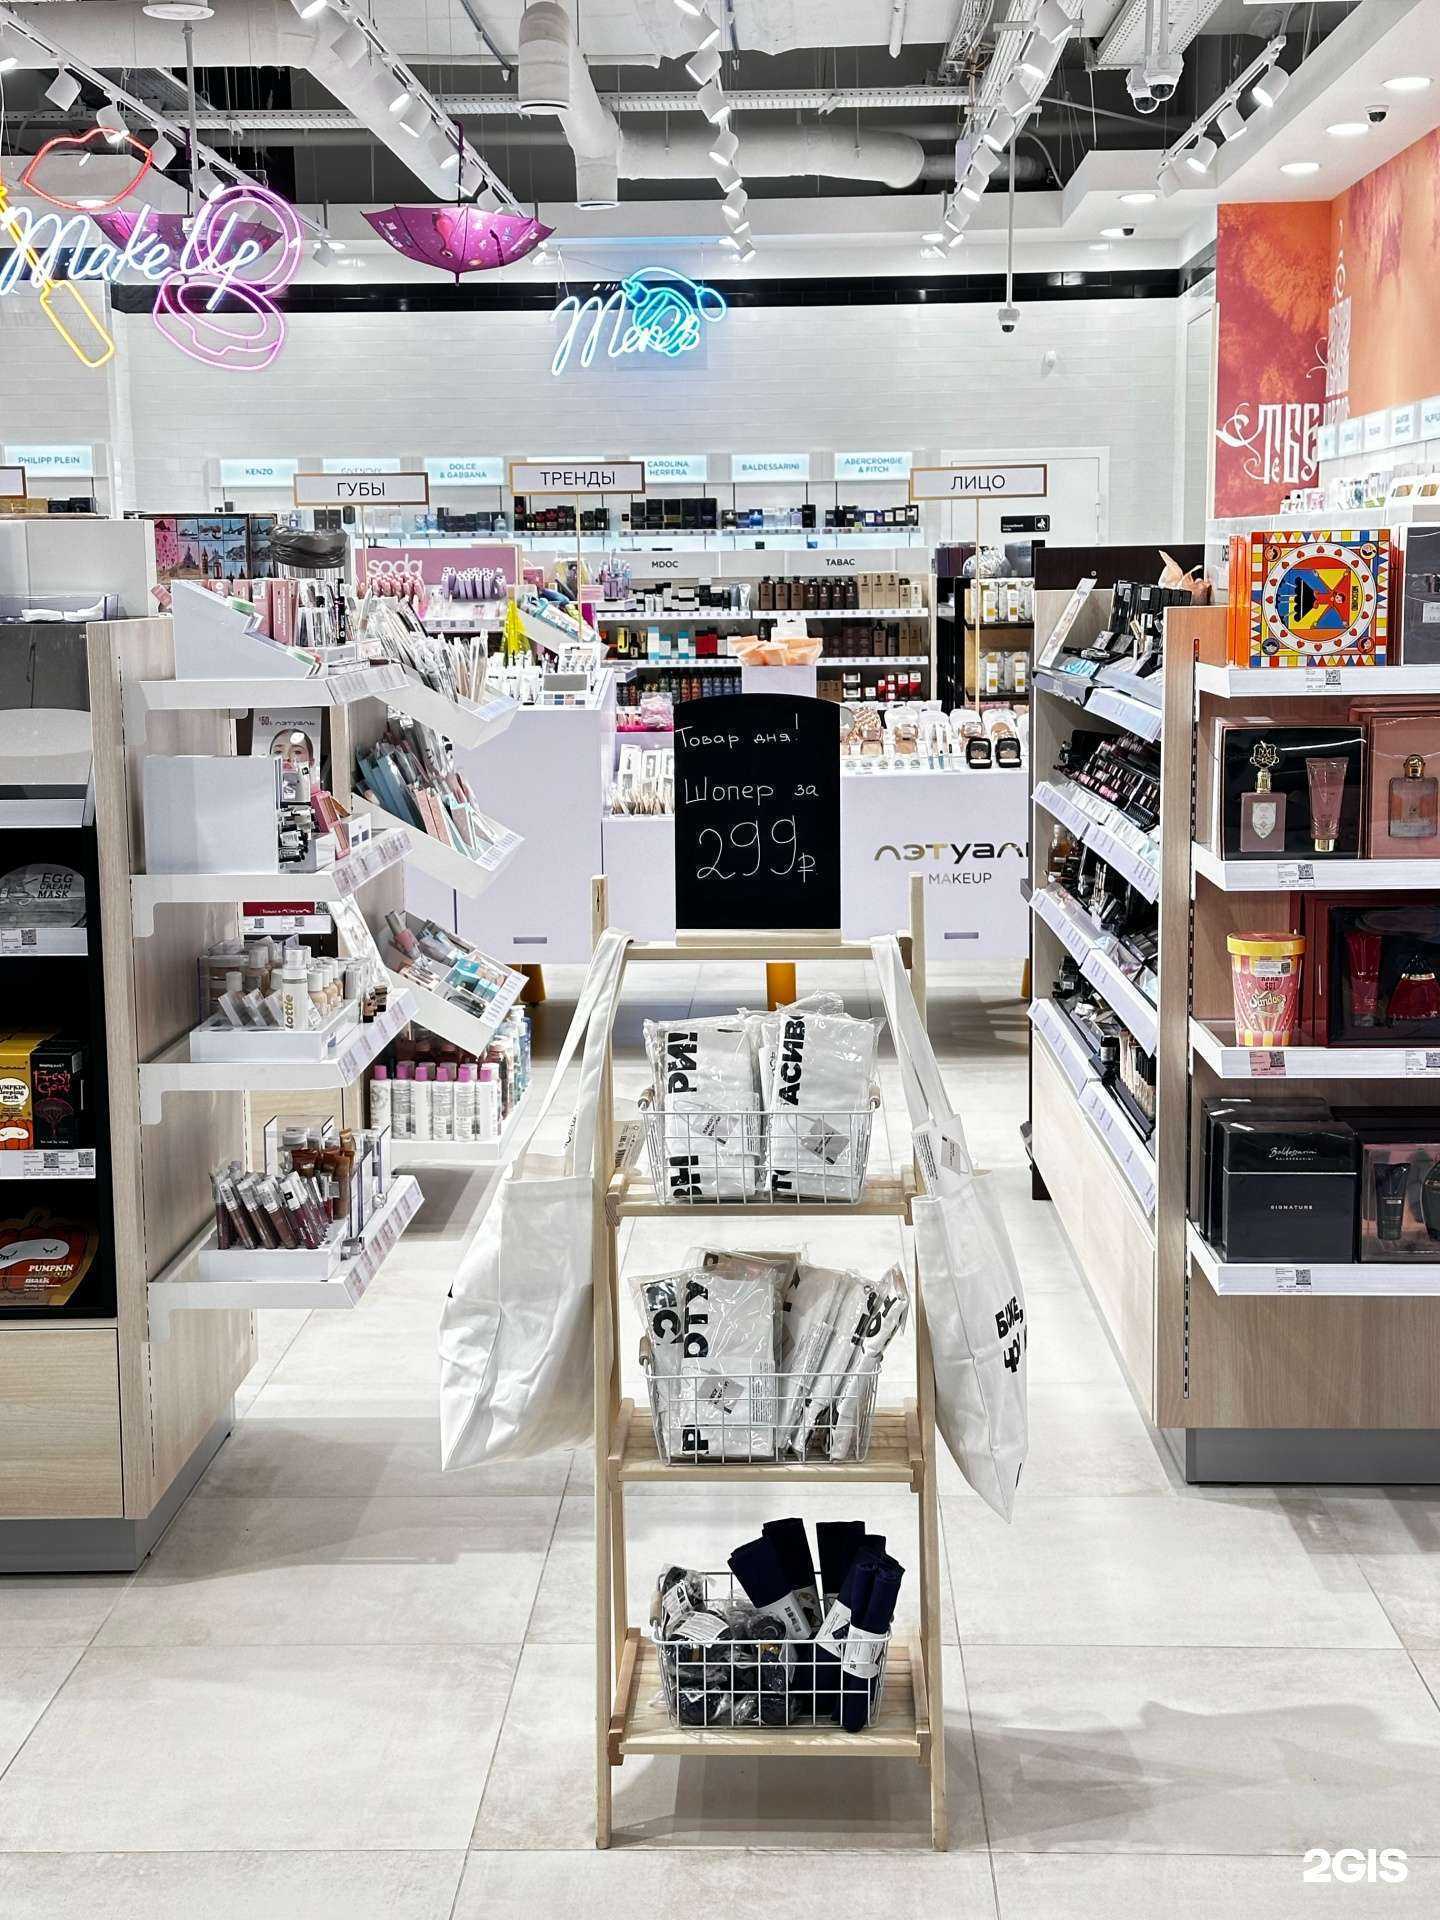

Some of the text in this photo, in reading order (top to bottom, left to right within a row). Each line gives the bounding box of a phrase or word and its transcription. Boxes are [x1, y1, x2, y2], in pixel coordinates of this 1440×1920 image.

[18, 456, 80, 465] PHILIPP PLEIN
[647, 460, 690, 468] CAROLINA
[844, 457, 904, 466] ABERCROMBIE
[449, 463, 476, 471] DOLCE
[741, 463, 801, 471] BALDESSARINI
[866, 464, 890, 473] FITCH
[245, 468, 274, 476] KENZO
[447, 471, 488, 479] GABBANA
[649, 469, 688, 477] HERRERA
[540, 471, 616, 488] ТРЕНДЫ
[950, 474, 1006, 491] ЛИЦО
[337, 482, 386, 497] ГУБЫ
[368, 553, 423, 578] soda
[651, 560, 679, 569] MDOC
[825, 558, 856, 567] TABAC
[676, 713, 800, 749] Товар дня!
[684, 776, 819, 806] Шопер за
[41, 872, 74, 883] EGG
[928, 872, 993, 885] MAKEUP
[37, 890, 70, 899] MASK
[29, 1264, 75, 1272] PUMPKIN
